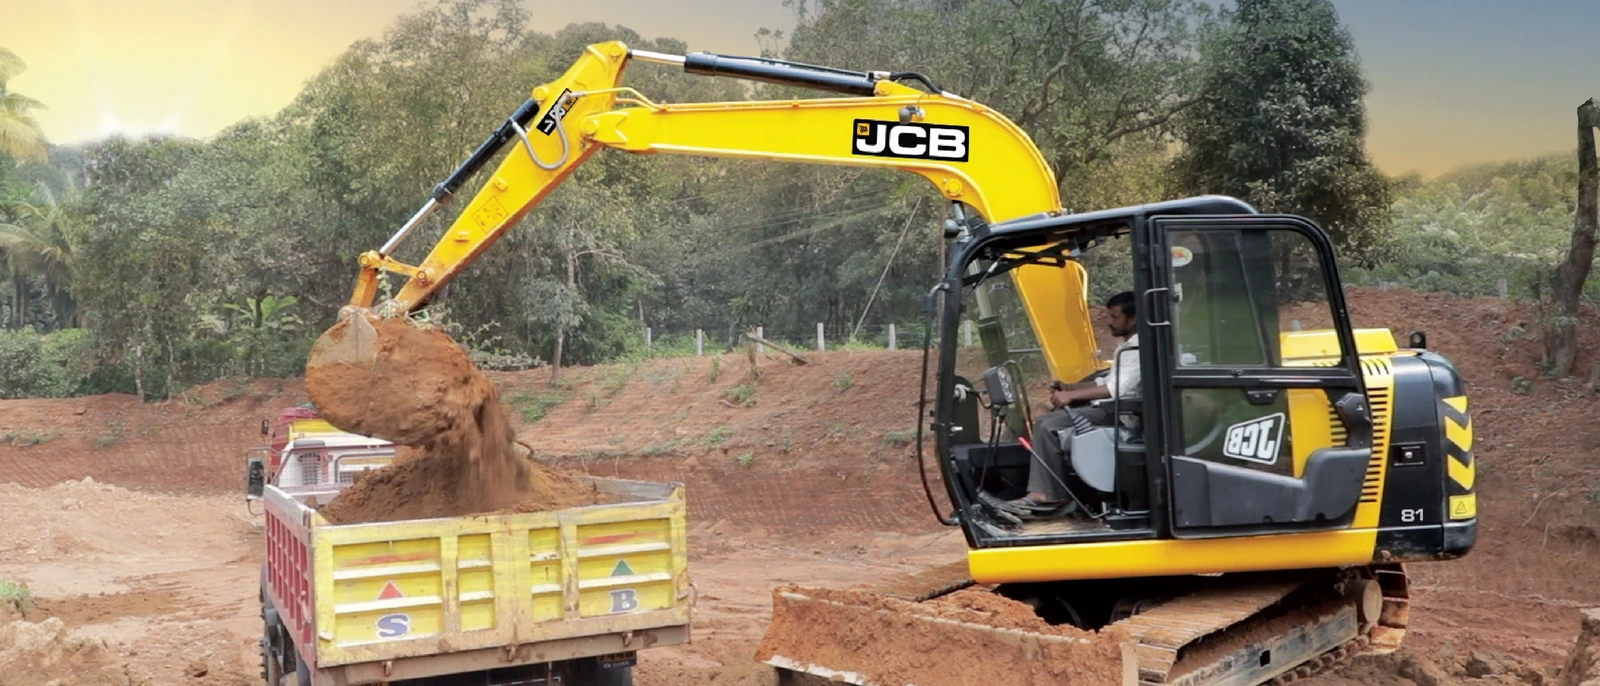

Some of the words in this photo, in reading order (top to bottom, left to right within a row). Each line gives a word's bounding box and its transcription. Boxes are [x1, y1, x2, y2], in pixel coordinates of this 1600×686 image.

[856, 124, 966, 158] JCB
[1401, 508, 1424, 522] 81
[609, 588, 639, 613] B
[376, 613, 410, 638] S
